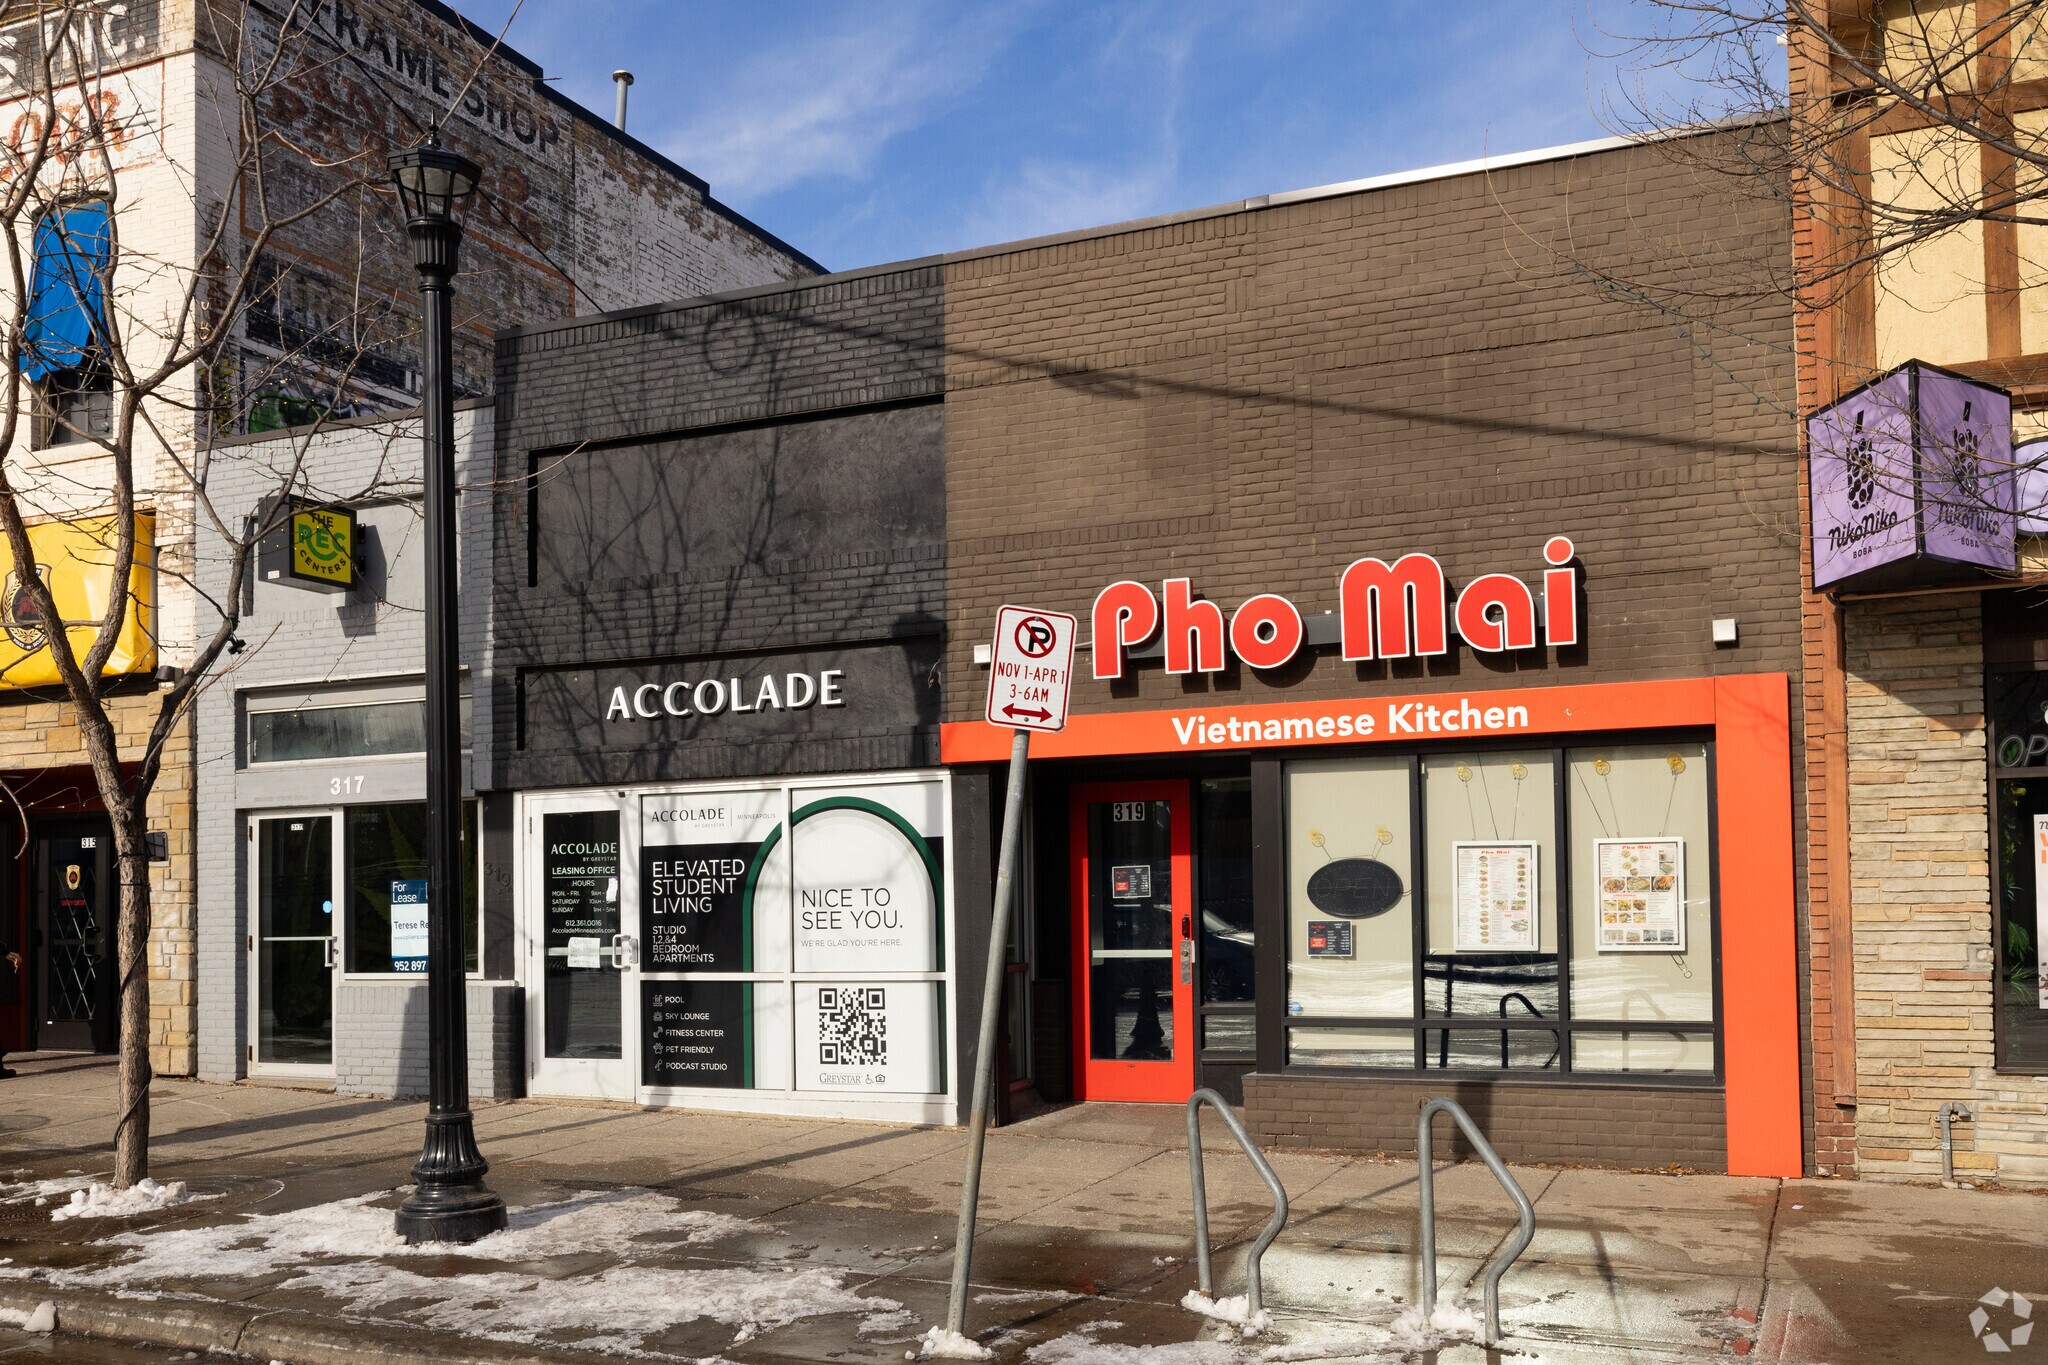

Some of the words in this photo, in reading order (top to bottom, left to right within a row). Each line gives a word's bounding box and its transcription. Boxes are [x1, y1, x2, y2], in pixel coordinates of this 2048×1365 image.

[311, 512, 334, 527] THE
[298, 523, 346, 562] REC
[300, 549, 347, 574] CENTERS
[998, 662, 1020, 678] NOV
[1025, 665, 1057, 683] 1-APR
[1061, 670, 1065, 684] 1
[606, 669, 846, 720] ACCOLADE
[1010, 684, 1049, 702] 3-6AM
[1171, 714, 1375, 745] Vietnamese
[1388, 698, 1528, 733] Kitchen
[330, 775, 365, 795] 317
[651, 807, 725, 823] ACCOLADE
[737, 812, 776, 820] MINNEAPOLIS
[1114, 803, 1144, 821] 319
[291, 823, 304, 831] 317
[82, 837, 96, 848] 315
[551, 842, 617, 855] ACCOLADE
[552, 867, 586, 875] LEASING
[587, 866, 616, 874] OFFICE
[652, 858, 745, 878] ELEVATED
[392, 881, 407, 892] For
[652, 877, 737, 896] STUDENT
[1314, 877, 1391, 899] OPEN
[392, 893, 418, 903] Lease
[652, 896, 713, 914] LIVING
[802, 888, 853, 908] NICE
[860, 887, 891, 907] TO
[393, 921, 418, 930] Terese
[802, 911, 842, 930] SEE
[850, 910, 903, 929] YOU.
[652, 925, 687, 935] STUDIO
[652, 944, 700, 954] BEDROOM
[880, 938, 903, 946] HERE.
[394, 962, 410, 971] 952
[411, 961, 427, 971] 897
[652, 953, 715, 963] APARTMENTS
[700, 1063, 728, 1071] STUDIO
